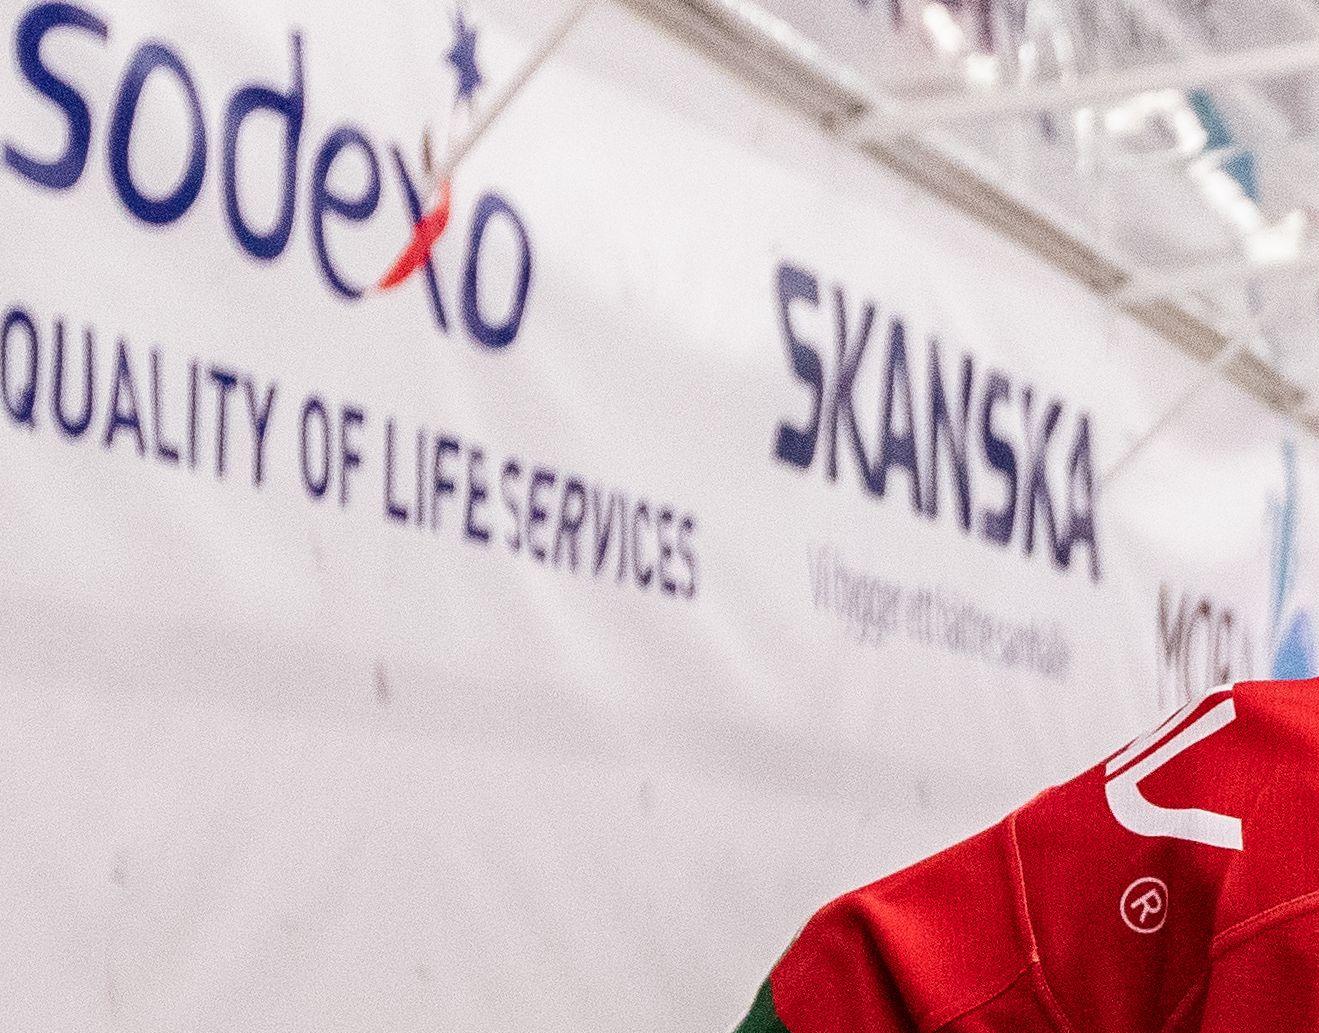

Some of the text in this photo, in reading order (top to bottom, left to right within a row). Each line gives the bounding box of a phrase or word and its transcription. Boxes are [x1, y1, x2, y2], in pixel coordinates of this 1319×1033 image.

[0, 306, 276, 487] QUALITY
[300, 396, 364, 509] OF
[773, 260, 1099, 585] SKANSKA
